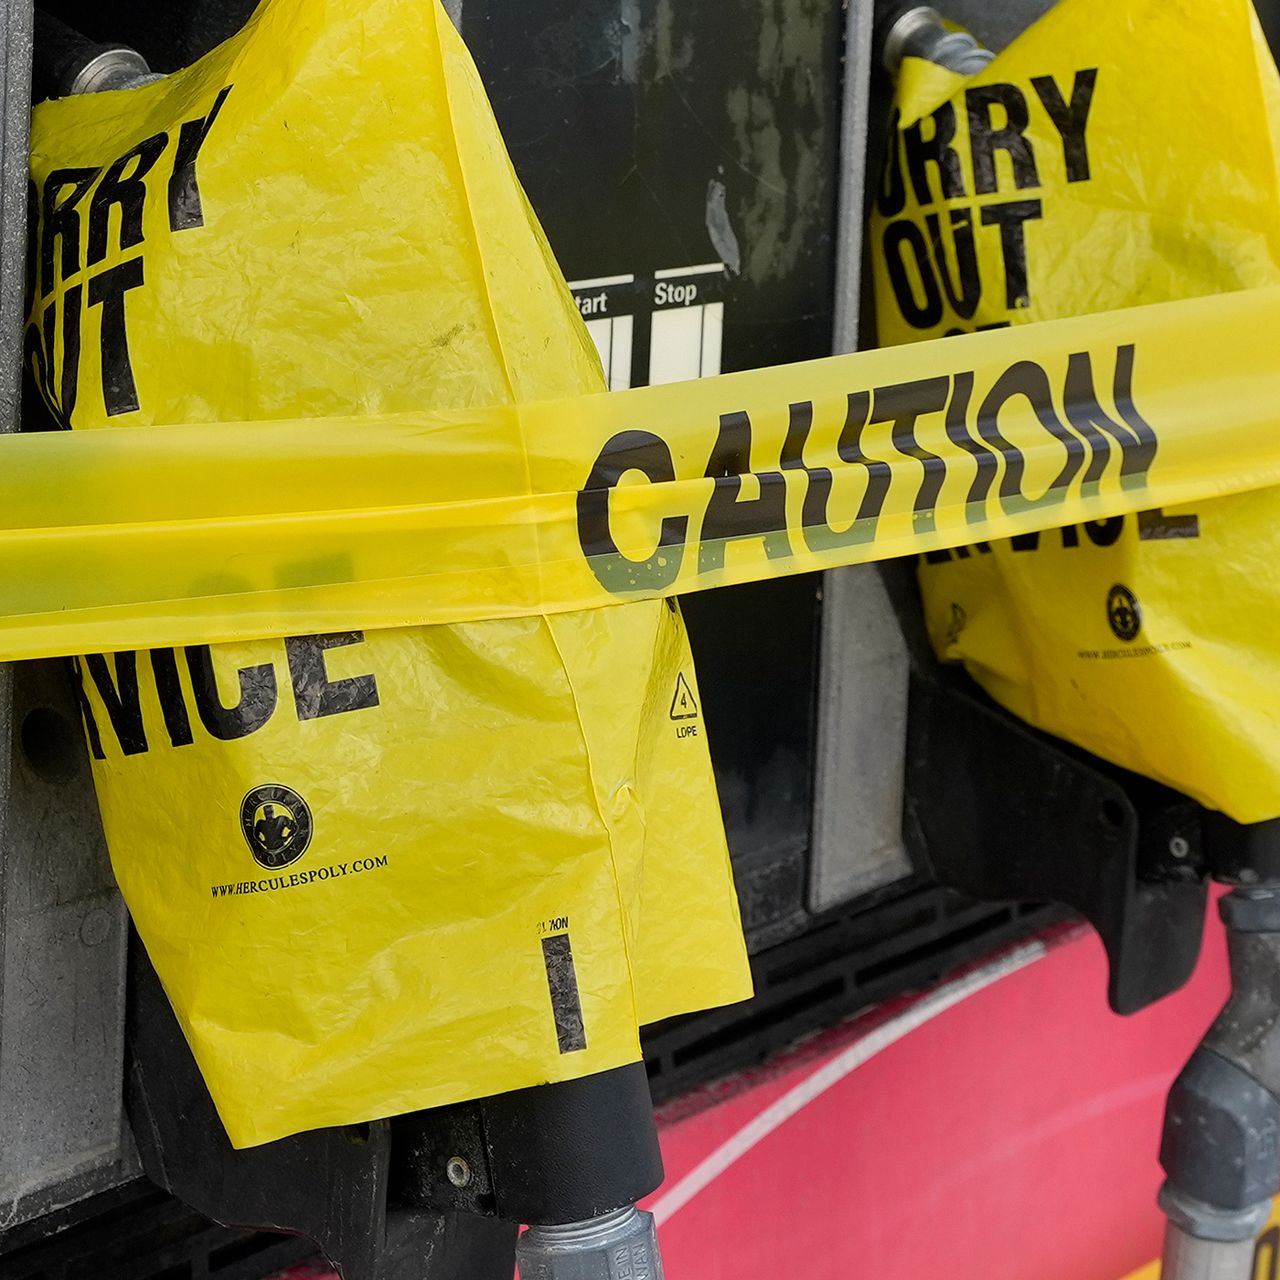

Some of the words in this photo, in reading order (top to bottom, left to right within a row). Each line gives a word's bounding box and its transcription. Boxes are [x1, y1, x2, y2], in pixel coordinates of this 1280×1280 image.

[882, 198, 1042, 331] OUT
[576, 291, 608, 316] tart
[654, 282, 697, 307] Stop
[577, 343, 1157, 593] CAUTION
[676, 725, 698, 739] LDPE
[210, 854, 388, 898] WWW.HERCULESPOLY.COM
